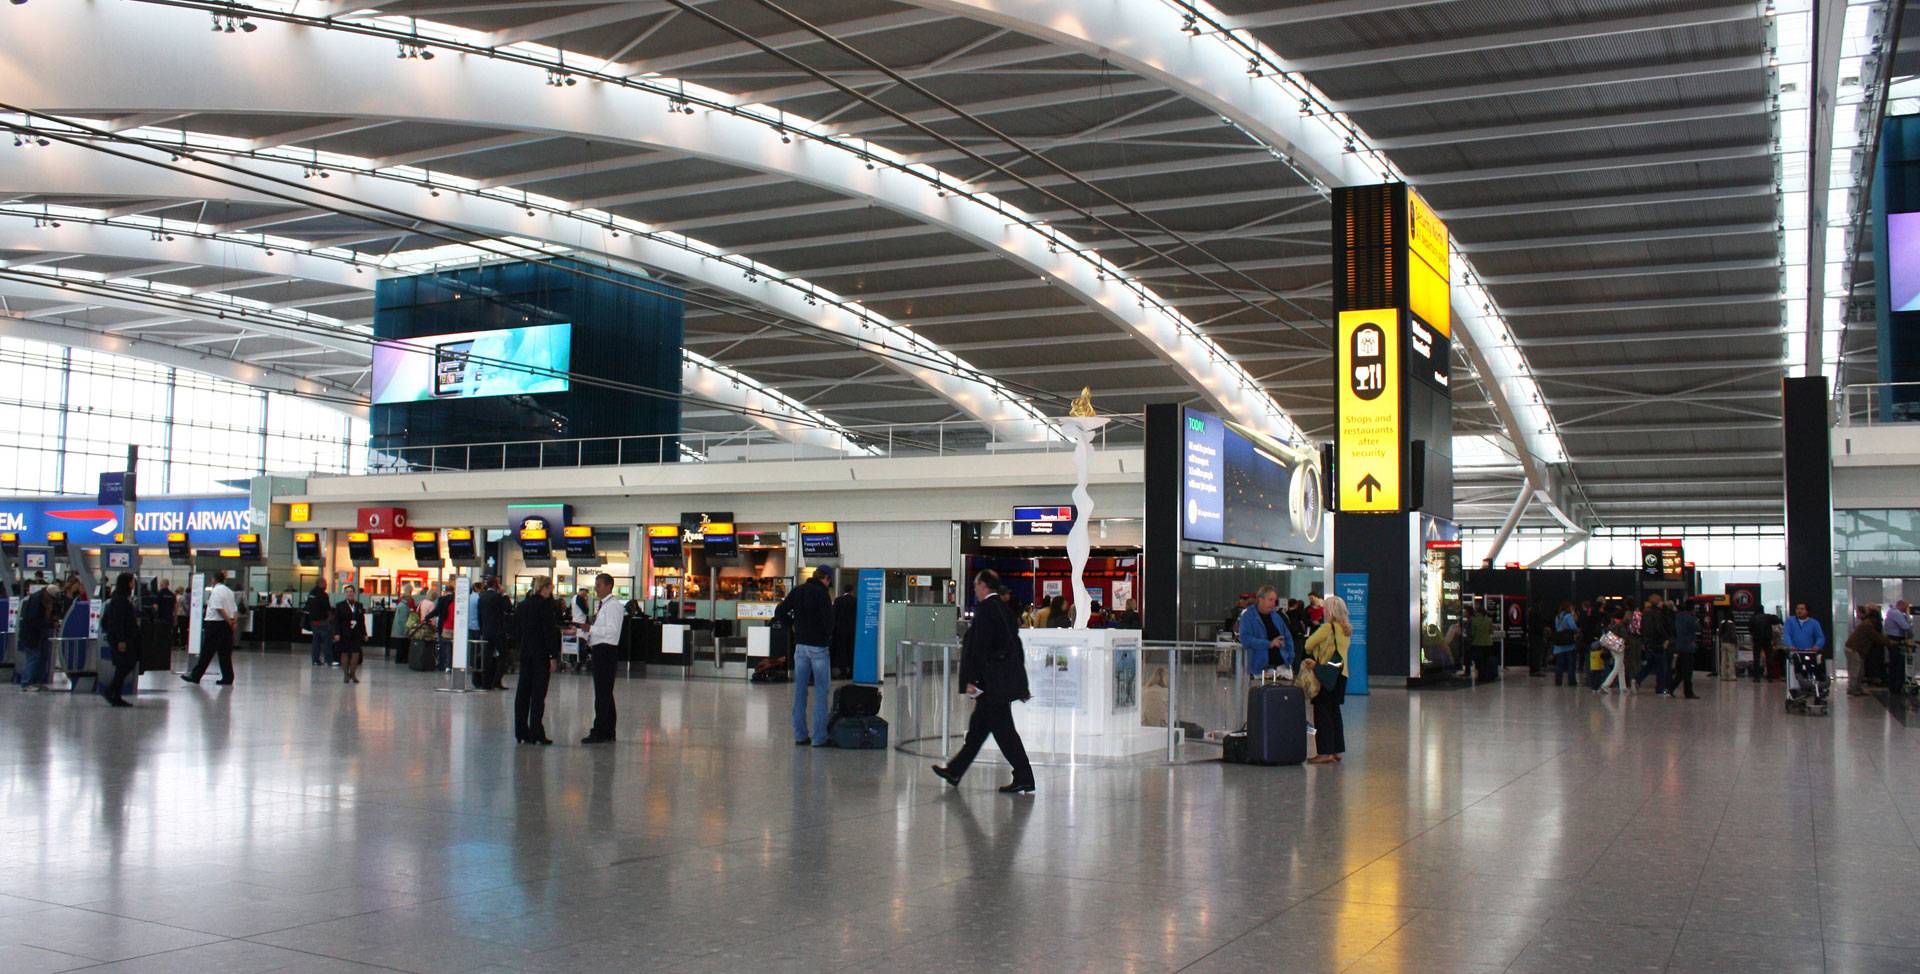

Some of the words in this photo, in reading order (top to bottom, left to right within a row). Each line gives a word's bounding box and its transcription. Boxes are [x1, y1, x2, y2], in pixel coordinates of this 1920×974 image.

[1345, 415, 1372, 424] Shops
[1375, 413, 1392, 423] and
[1343, 426, 1394, 435] restaurants
[1358, 437, 1379, 446] after
[1351, 449, 1386, 458] security
[134, 509, 184, 532] RITISH
[187, 510, 250, 531] AIRWAYS
